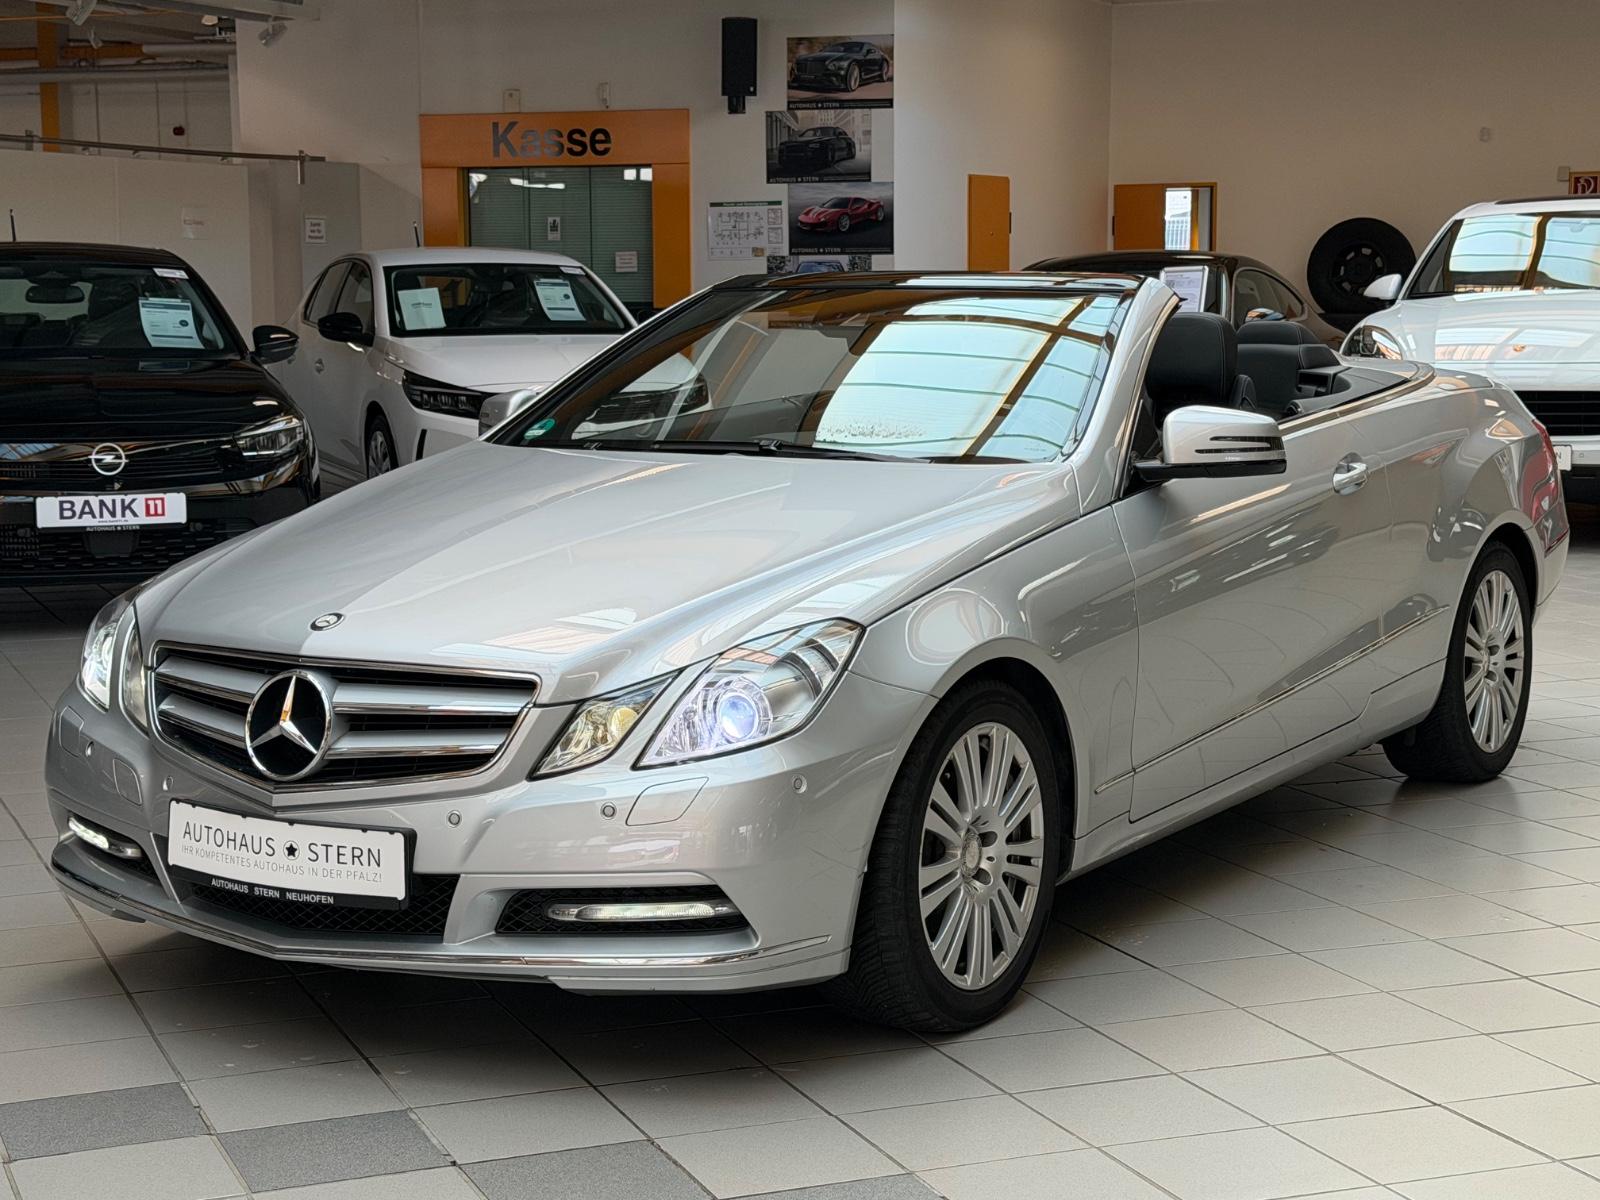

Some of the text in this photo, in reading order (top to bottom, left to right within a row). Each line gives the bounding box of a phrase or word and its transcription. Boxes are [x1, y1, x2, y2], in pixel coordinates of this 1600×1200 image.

[491, 121, 612, 158] Kasse
[58, 498, 164, 520] BANK 11
[182, 820, 381, 868] AUTOHAUS STERN
[181, 844, 382, 883] IHR KOMPETENTES AUTOHAUS IN DER PFALZ!
[211, 877, 334, 905] AUTOHAUS STERN NEUHOFEN
